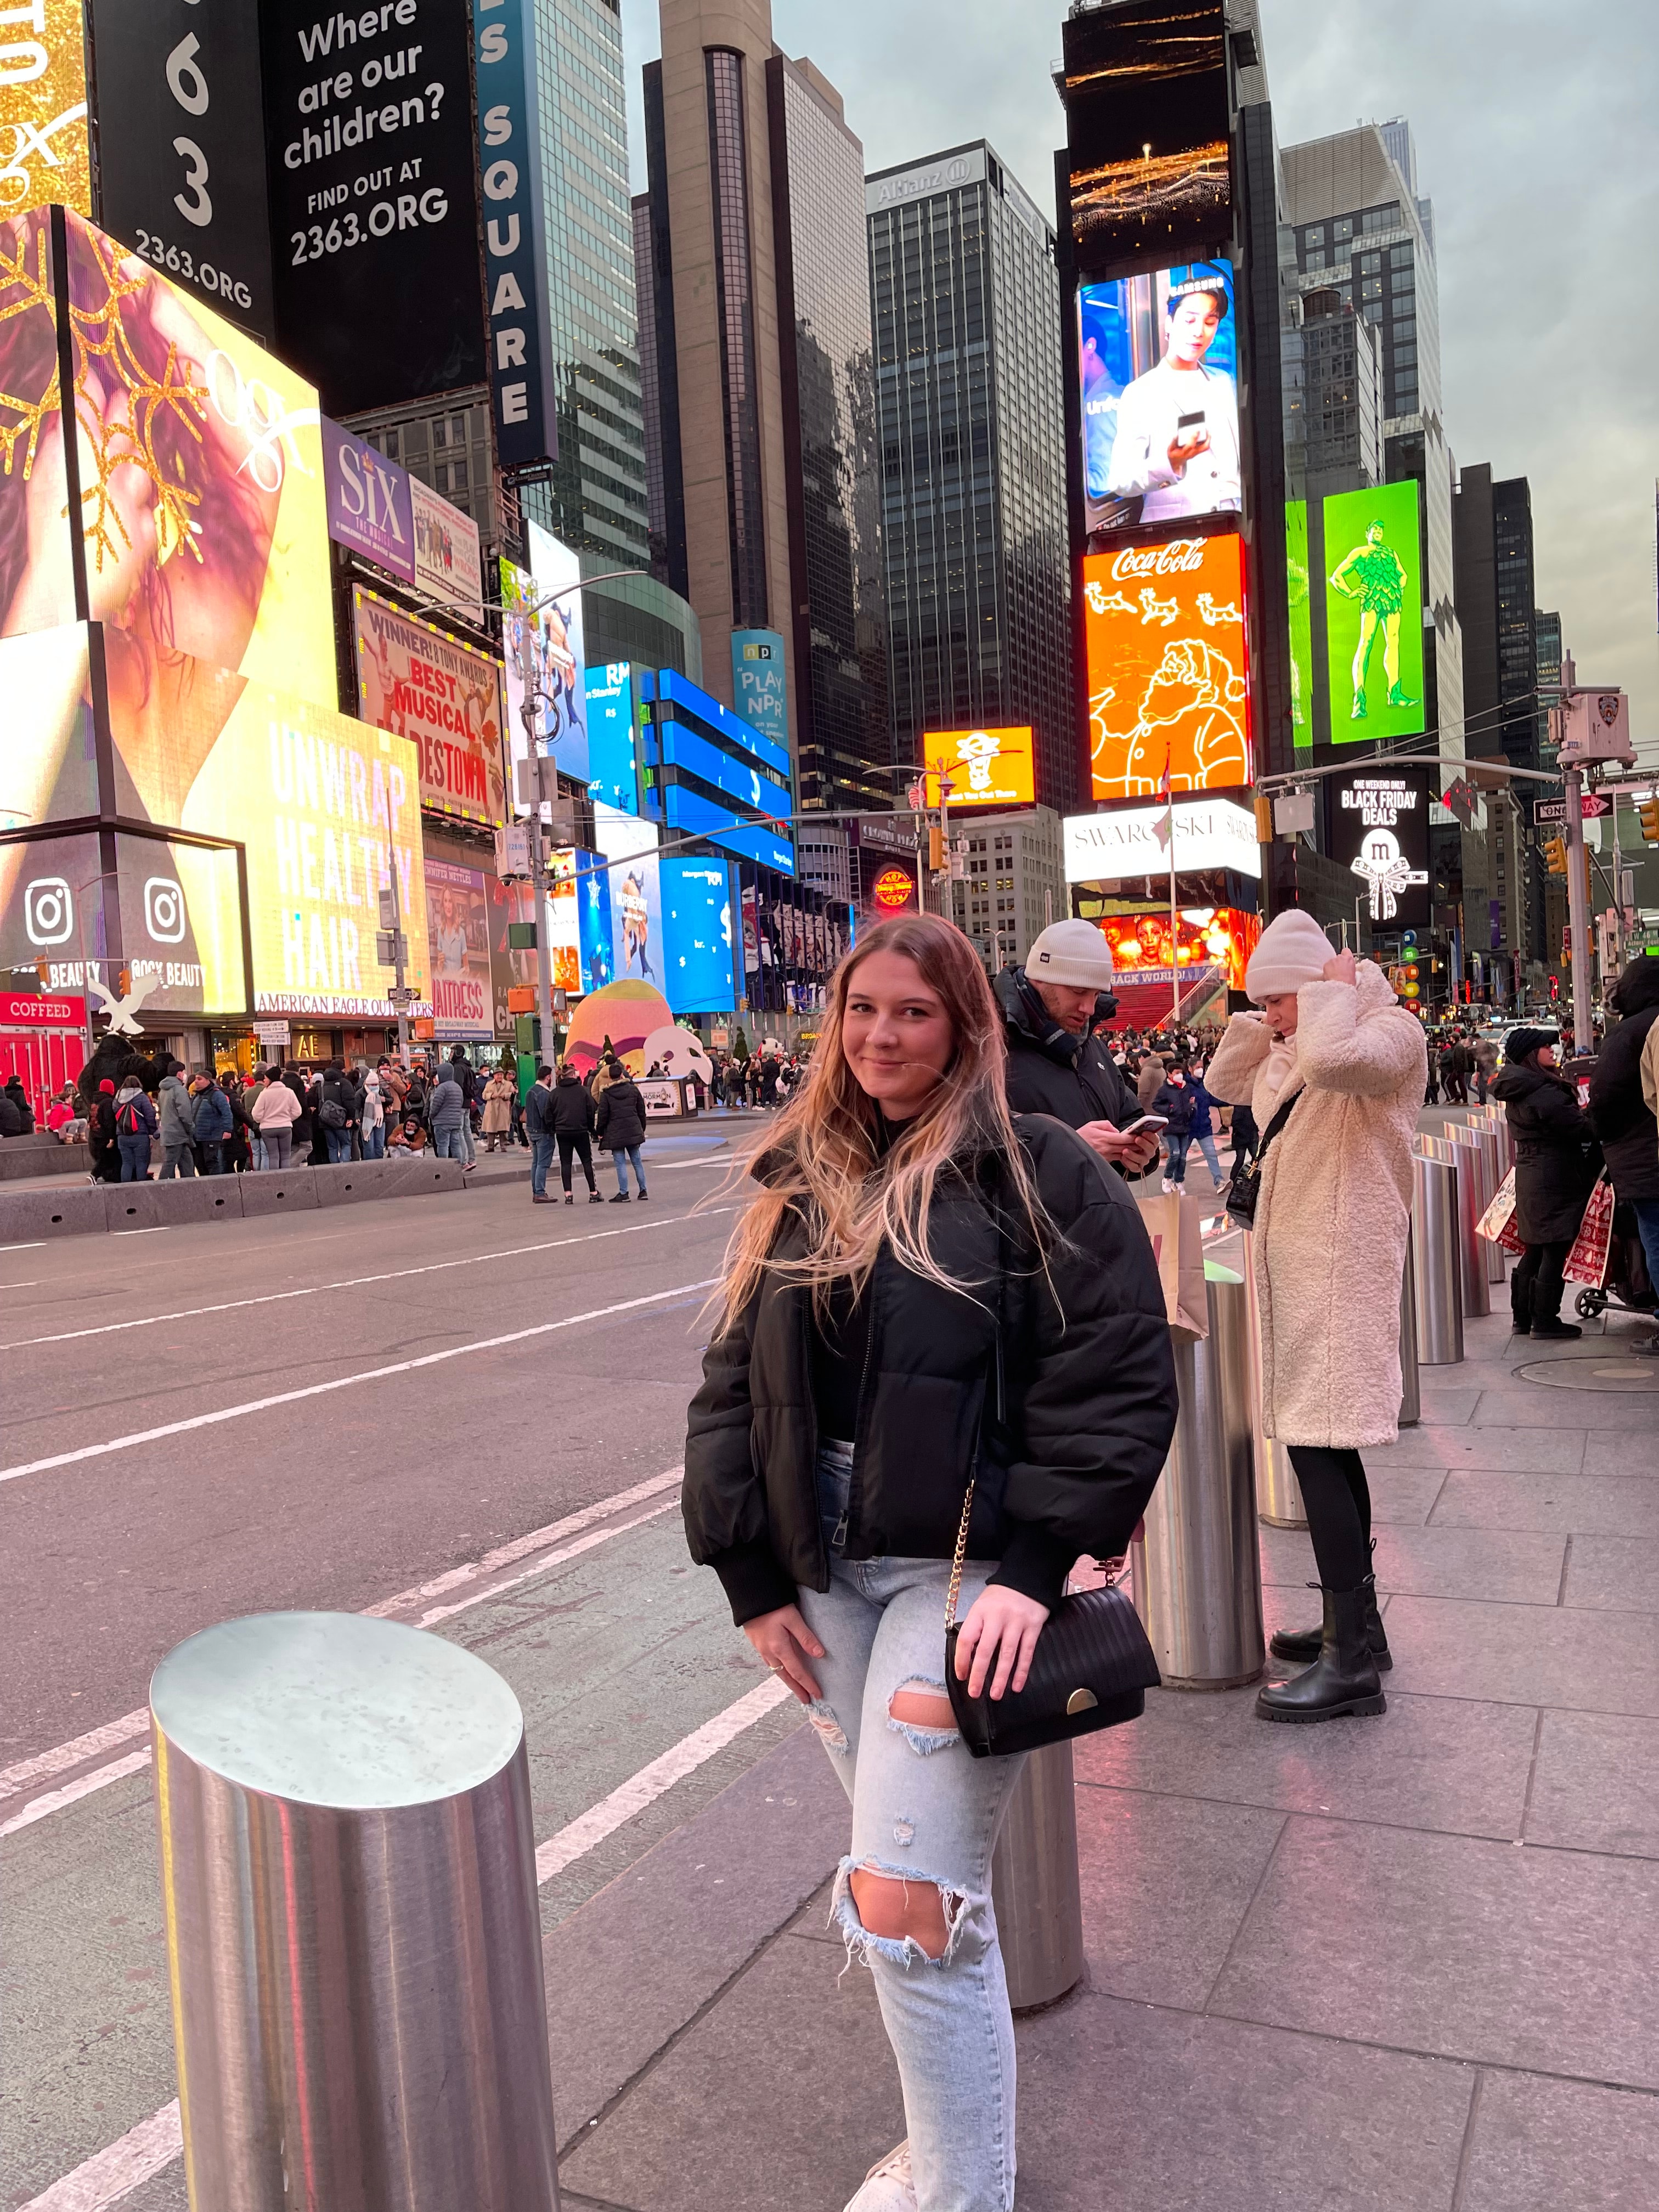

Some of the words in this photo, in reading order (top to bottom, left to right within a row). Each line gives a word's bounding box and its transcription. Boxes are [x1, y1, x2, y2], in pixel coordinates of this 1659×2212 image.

[297, 0, 417, 63] Where
[298, 72, 353, 114] are
[360, 46, 423, 88] our
[284, 82, 445, 170] children?
[307, 185, 349, 215] FIND
[354, 168, 393, 197] OUT
[399, 158, 423, 183] AT
[878, 172, 942, 204] Allianz
[290, 188, 449, 266] 2363.ORG
[135, 229, 253, 309] 2363.ORG
[483, 105, 528, 425] SQUARE
[1169, 278, 1224, 297] SAMSUNG
[338, 444, 405, 544] SIX
[368, 610, 433, 661] WINNER!
[439, 646, 459, 673] TONY
[460, 657, 488, 687] AWARDS
[747, 647, 776, 658] npr
[410, 657, 456, 702] BEST
[394, 682, 476, 741] MUSICAL
[269, 721, 406, 832] UNWRAP
[1353, 780, 1364, 789] ONE
[1365, 780, 1390, 789] WEEKEND
[1391, 780, 1406, 789] ONLY!
[1341, 790, 1378, 808] BLACK
[1379, 791, 1417, 809] FRIDAY
[1362, 808, 1397, 826] DEALS
[275, 814, 411, 915] HEALTHY
[1372, 843, 1390, 860] m
[616, 891, 647, 912] BURBERRY
[281, 908, 362, 991] HAIR
[10, 1002, 71, 1018] COFFEED
[258, 993, 329, 1014] AMERICAN
[332, 997, 368, 1015] EAGLE
[498, 986, 507, 998] RA
[496, 1005, 515, 1030] CH
[297, 1035, 319, 1058] AE
